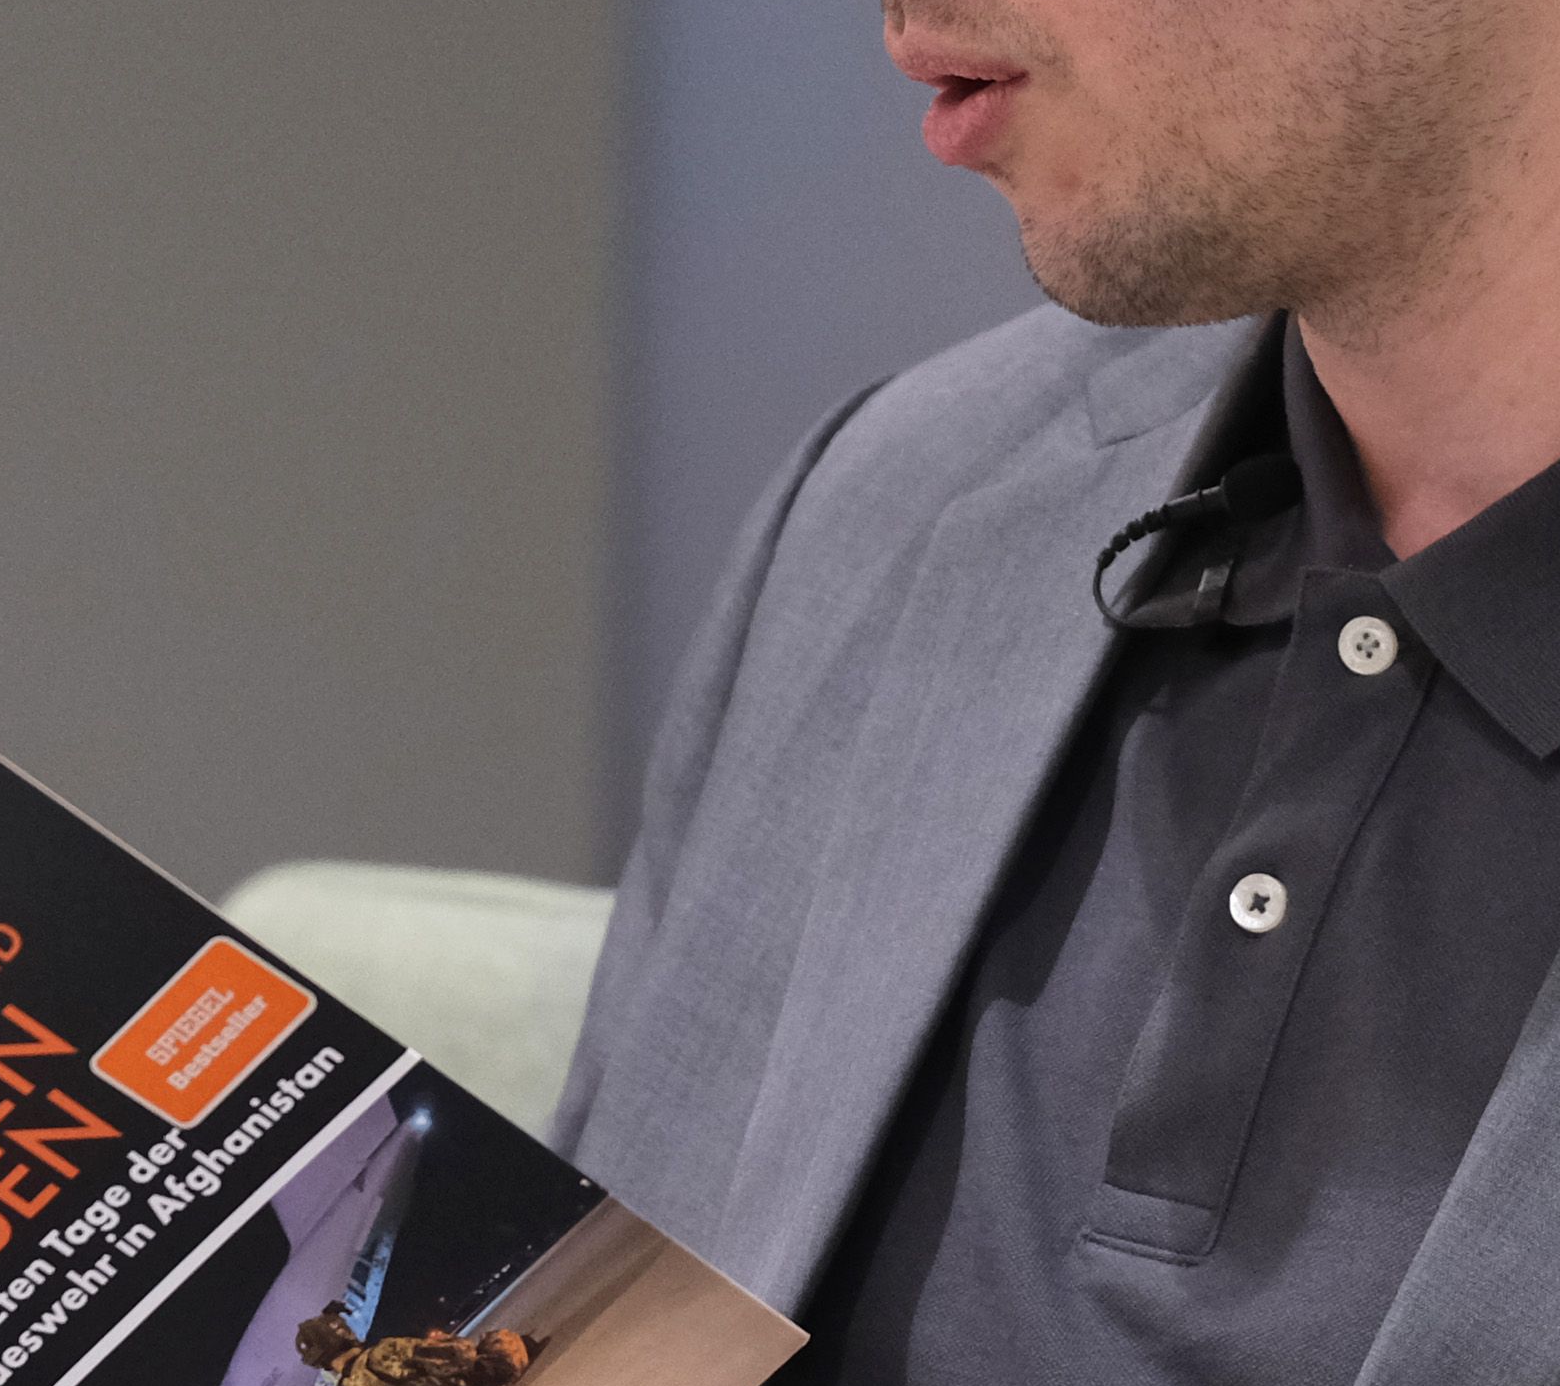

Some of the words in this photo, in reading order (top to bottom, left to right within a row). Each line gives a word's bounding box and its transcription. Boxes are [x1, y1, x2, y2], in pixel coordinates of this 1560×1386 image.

[144, 985, 236, 1067] SPIEGEL
[166, 994, 270, 1092] Bestseller
[38, 1183, 133, 1255] Tage
[127, 1123, 195, 1186] der
[106, 1221, 157, 1261] in
[145, 1044, 346, 1227] Afghanistan
